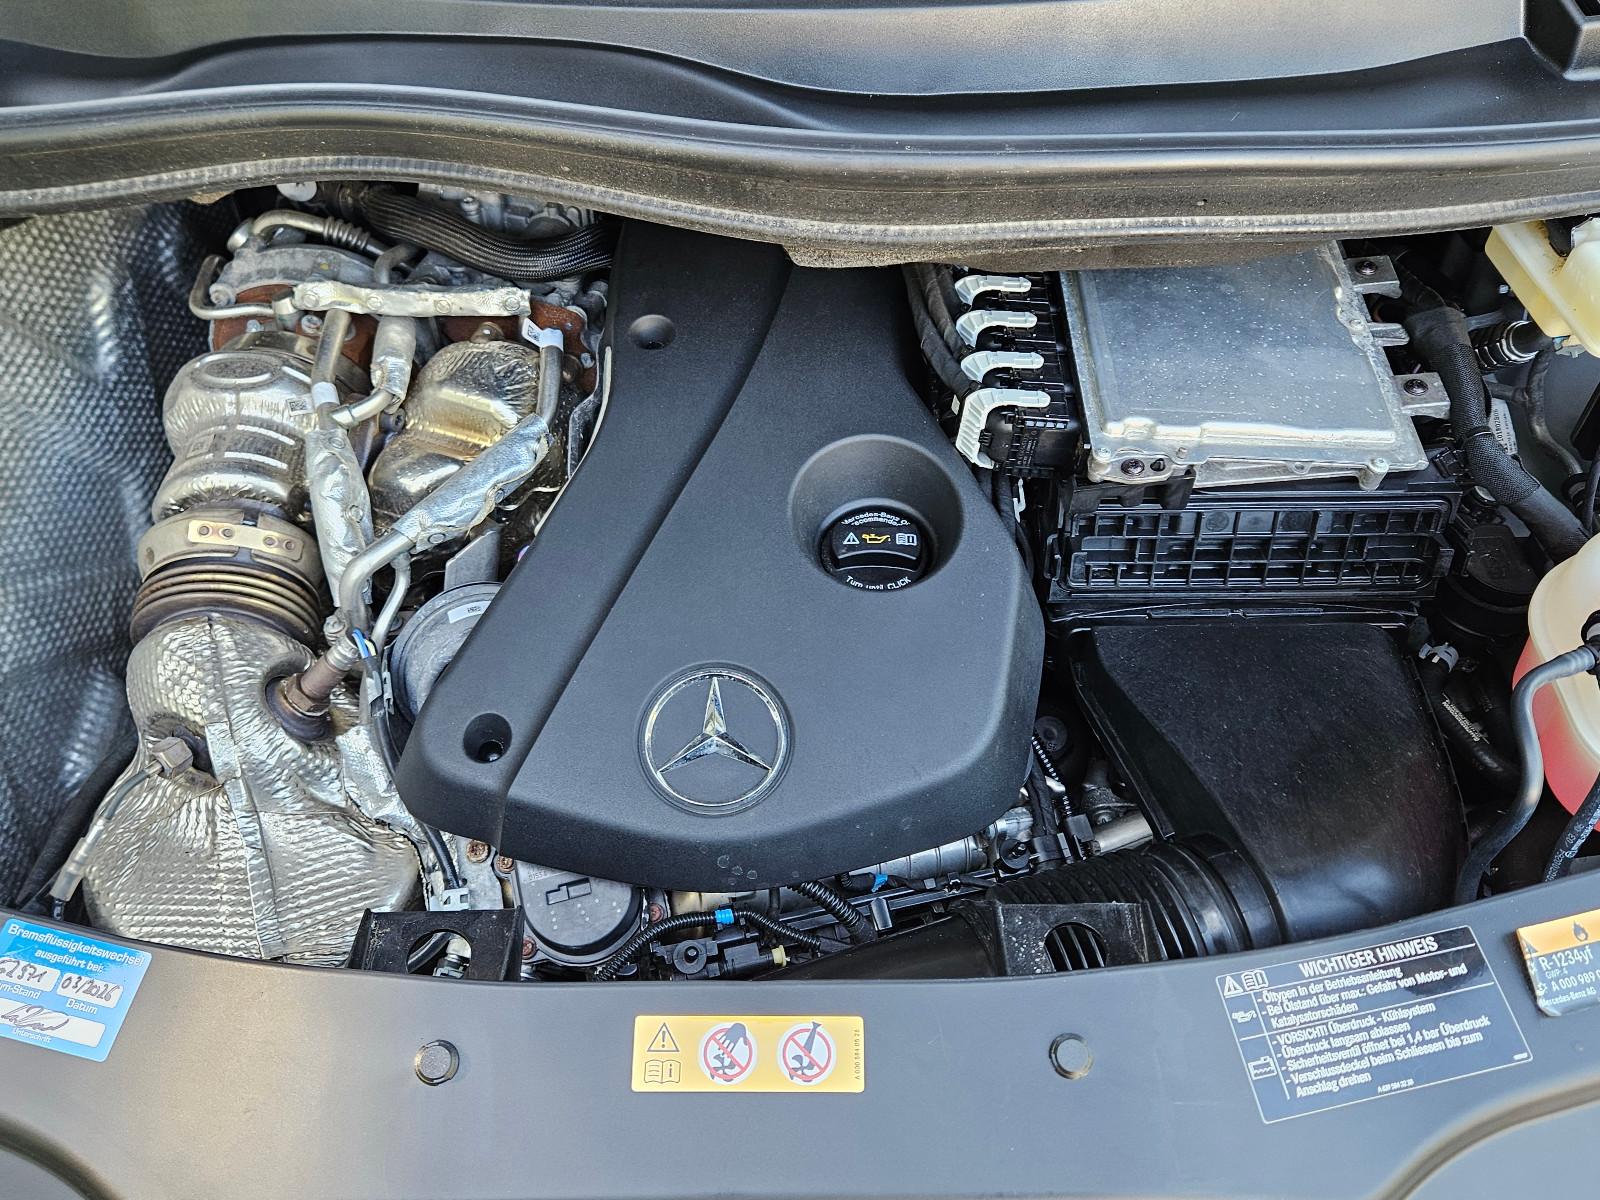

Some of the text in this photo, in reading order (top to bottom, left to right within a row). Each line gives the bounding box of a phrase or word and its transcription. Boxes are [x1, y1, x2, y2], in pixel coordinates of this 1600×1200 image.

[845, 575, 864, 588] Turn
[886, 576, 912, 590] CLICK
[7, 923, 144, 967] Bremsflüssigkeitswechsel
[34, 949, 87, 969] ausgeführt
[1298, 936, 1439, 978] WICHTIGER HINWEIS
[1538, 944, 1594, 971] R-1234yf
[1262, 989, 1298, 1006] Öltypen
[1297, 985, 1309, 996] in
[1308, 982, 1325, 995] der
[1324, 966, 1404, 991] Betriebsanleitung
[1266, 1003, 1283, 1017] Bei
[1318, 992, 1340, 1006] über
[1366, 980, 1398, 996] Gefahr
[1397, 976, 1417, 989] von
[1415, 969, 1448, 985] Motor-
[1447, 962, 1468, 978] und
[1550, 980, 1560, 992] A
[1559, 975, 1578, 991] 000
[1577, 970, 1595, 985] 989
[66, 998, 98, 1015] Datum
[1270, 1002, 1359, 1029] Katalysatorschäden
[1328, 1015, 1377, 1034] Überdruck
[1381, 1002, 1437, 1022] Kühlsystem
[1281, 1038, 1330, 1059] Überdruck
[1330, 1031, 1370, 1048] langsam
[1370, 1022, 1411, 1039] ablassen
[1286, 1045, 1362, 1071] Sicherheitsventil
[1361, 1040, 1390, 1055] öffnet
[1389, 1034, 1407, 1048] bei
[1406, 1031, 1423, 1045] 1,4
[1422, 1027, 1440, 1040] bar
[1439, 1014, 1491, 1036] Überdruck
[1289, 1056, 1371, 1085] Verschlussdeckel
[1369, 1052, 1396, 1067] beim
[1394, 1041, 1446, 1061] Schliessen
[1444, 1036, 1461, 1049] bis
[1460, 1031, 1484, 1045] zum
[1296, 1072, 1372, 1098] Anschlag drehen
